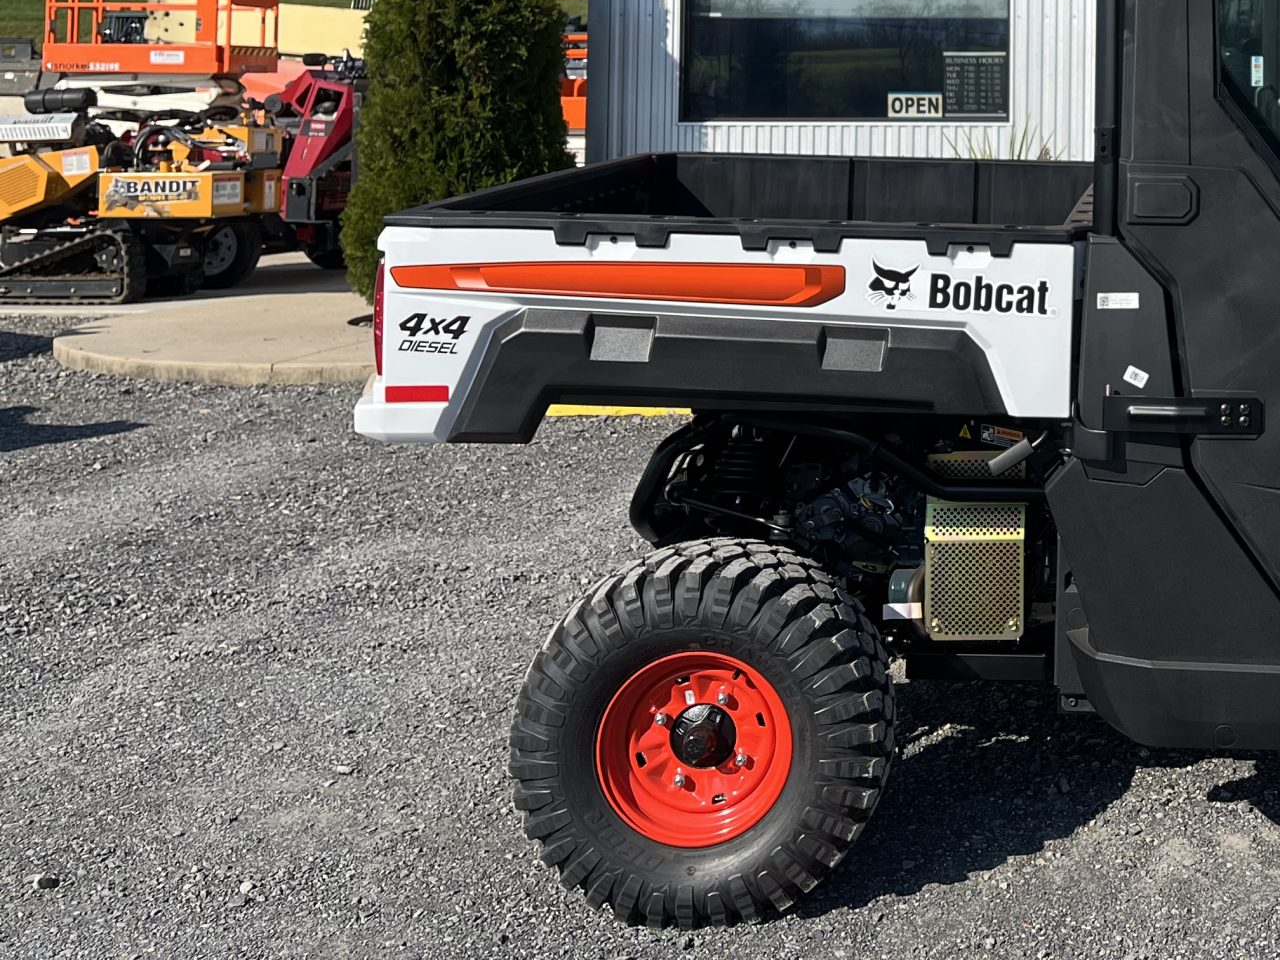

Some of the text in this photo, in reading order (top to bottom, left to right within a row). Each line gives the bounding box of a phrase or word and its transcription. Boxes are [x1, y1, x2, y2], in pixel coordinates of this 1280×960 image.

[891, 96, 940, 115] OPEN
[126, 179, 199, 194] BANDIT
[928, 272, 1049, 315] Bobcat
[398, 312, 472, 340] 4x4
[398, 339, 458, 355] DIESEL
